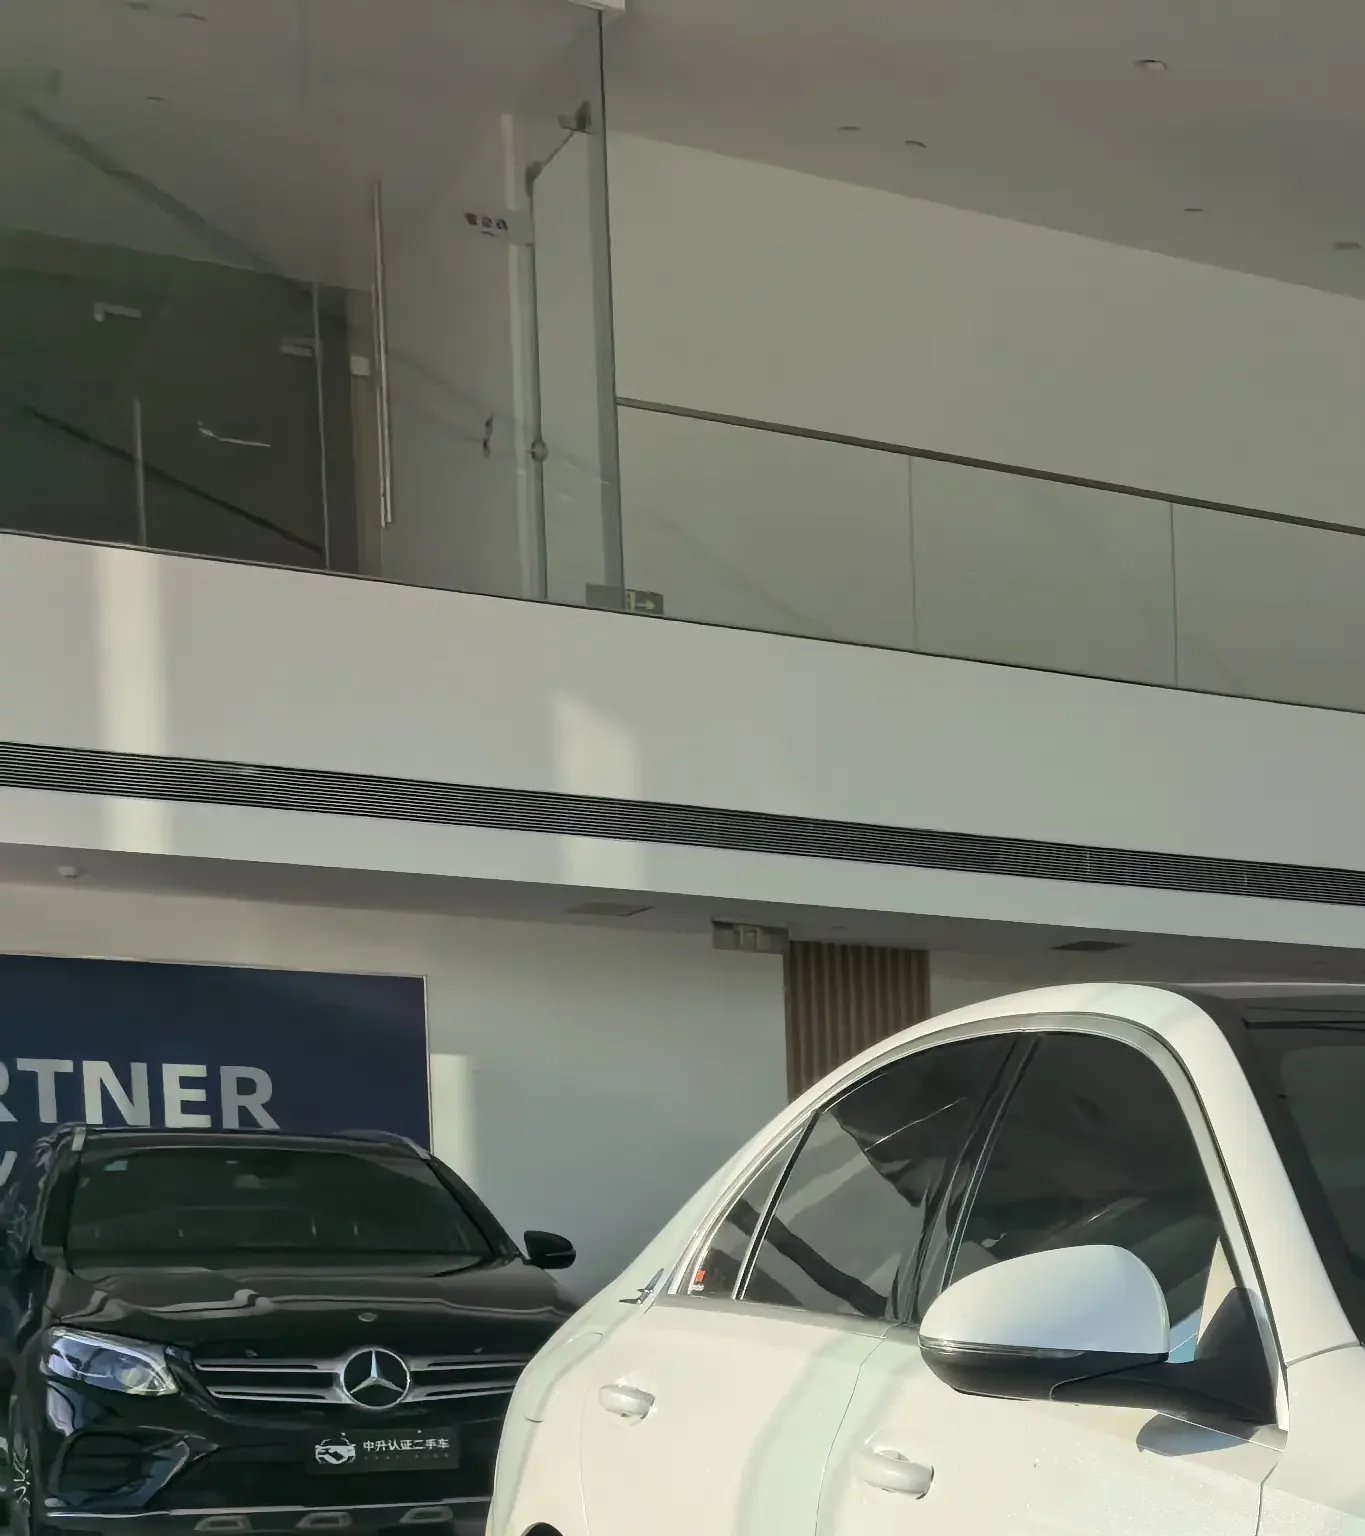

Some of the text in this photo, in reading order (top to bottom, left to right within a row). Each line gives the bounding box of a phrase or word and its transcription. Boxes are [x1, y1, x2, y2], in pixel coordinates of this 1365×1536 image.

[0, 1057, 281, 1131] TNER
[362, 1438, 450, 1452] 中升认证二手车
